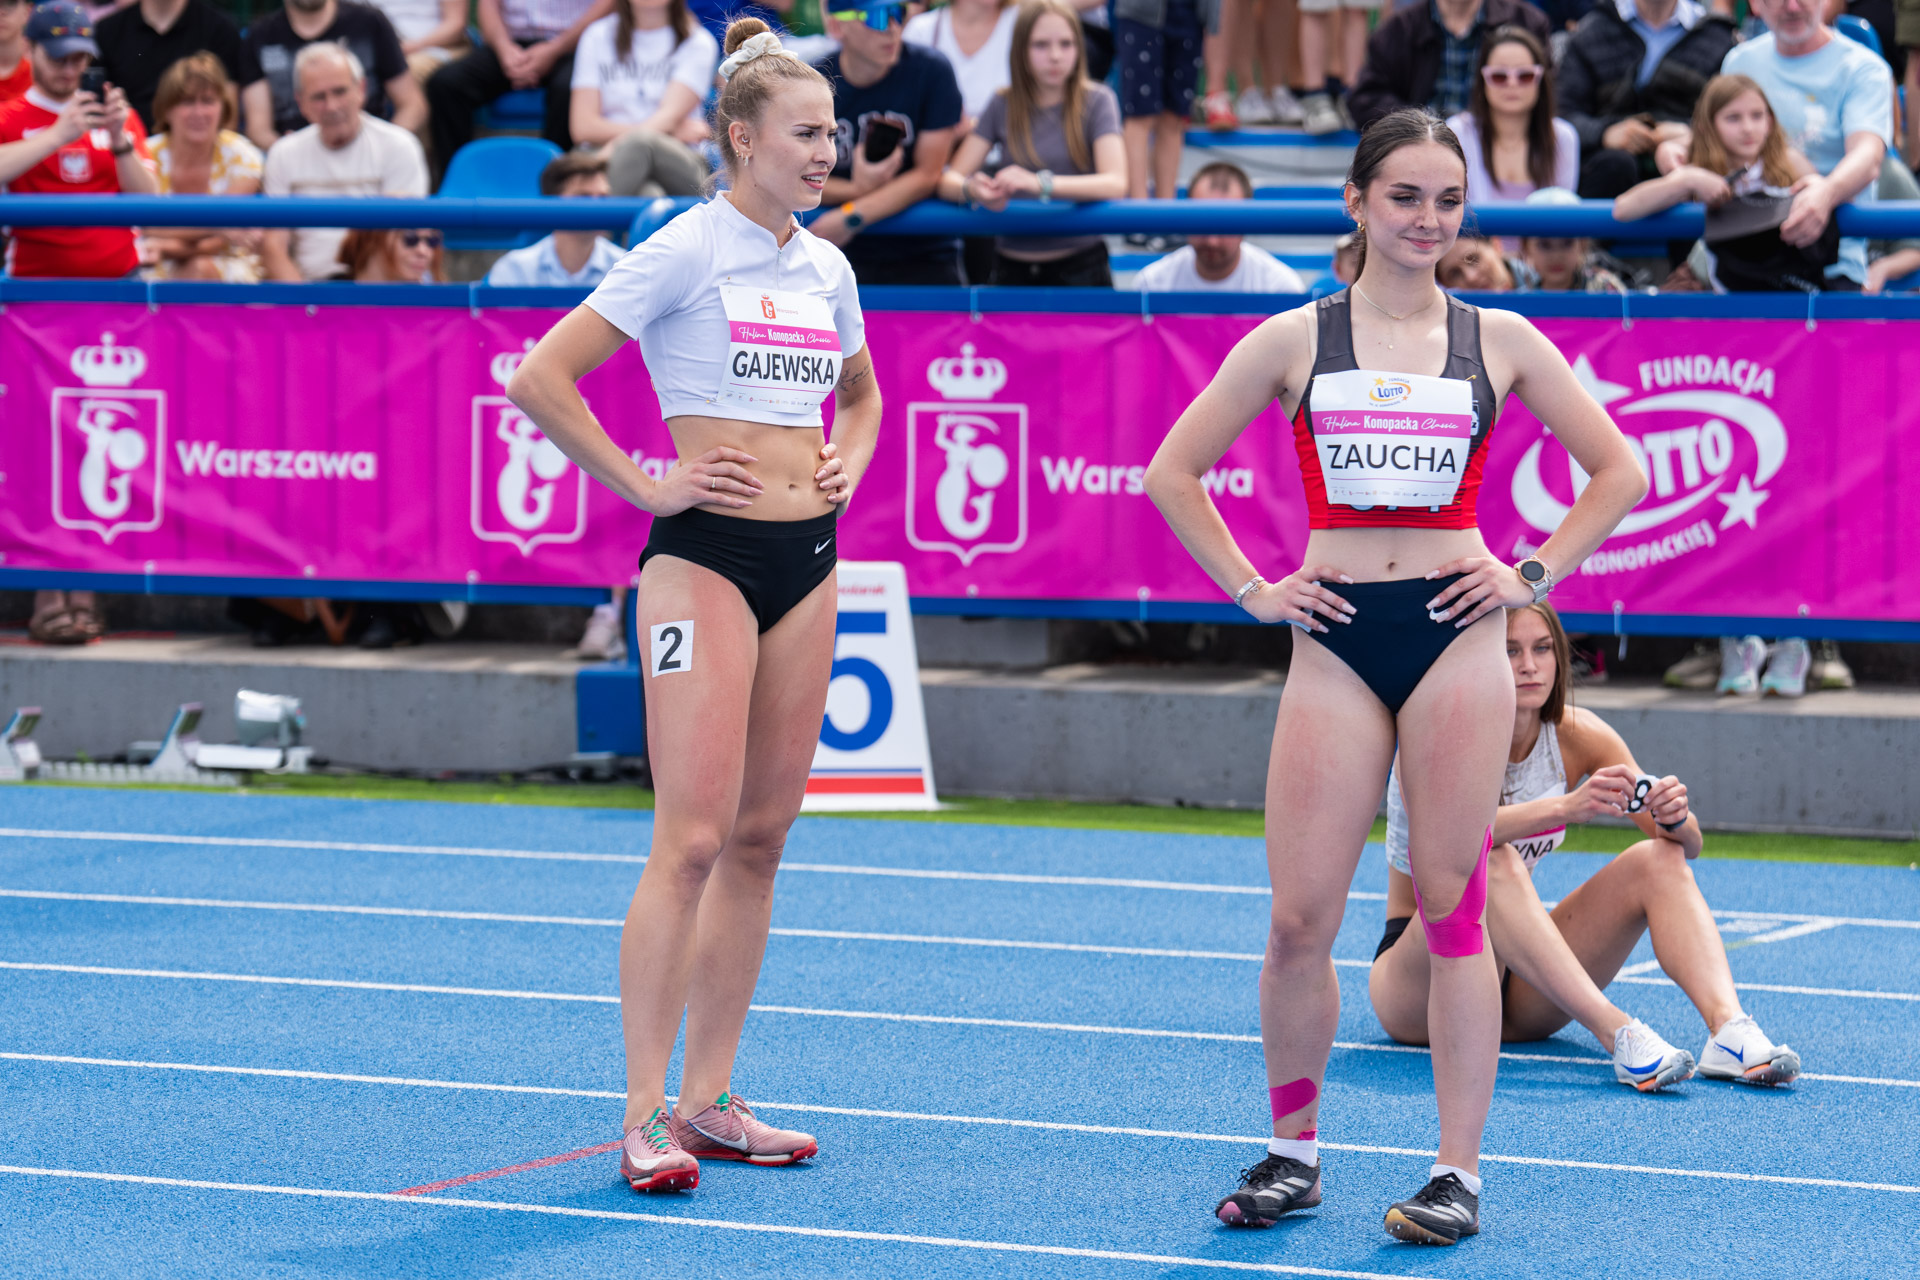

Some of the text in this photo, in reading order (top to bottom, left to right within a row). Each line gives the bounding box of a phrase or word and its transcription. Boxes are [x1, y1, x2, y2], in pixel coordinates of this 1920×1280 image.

[739, 326, 831, 344] Halina Konopacka Classic
[732, 350, 834, 385] GAJEWSKA
[1638, 354, 1775, 400] FUNDACJA
[1377, 386, 1404, 398] LOTTO
[1322, 416, 1361, 432] Halina
[1363, 415, 1418, 432] Konopacka
[1420, 418, 1459, 430] Classic
[175, 439, 377, 481] Warszawa
[1041, 456, 1255, 498] Warswa
[1326, 444, 1456, 474] ZAUCHA
[658, 626, 683, 672] 2
[818, 611, 894, 753] 5
